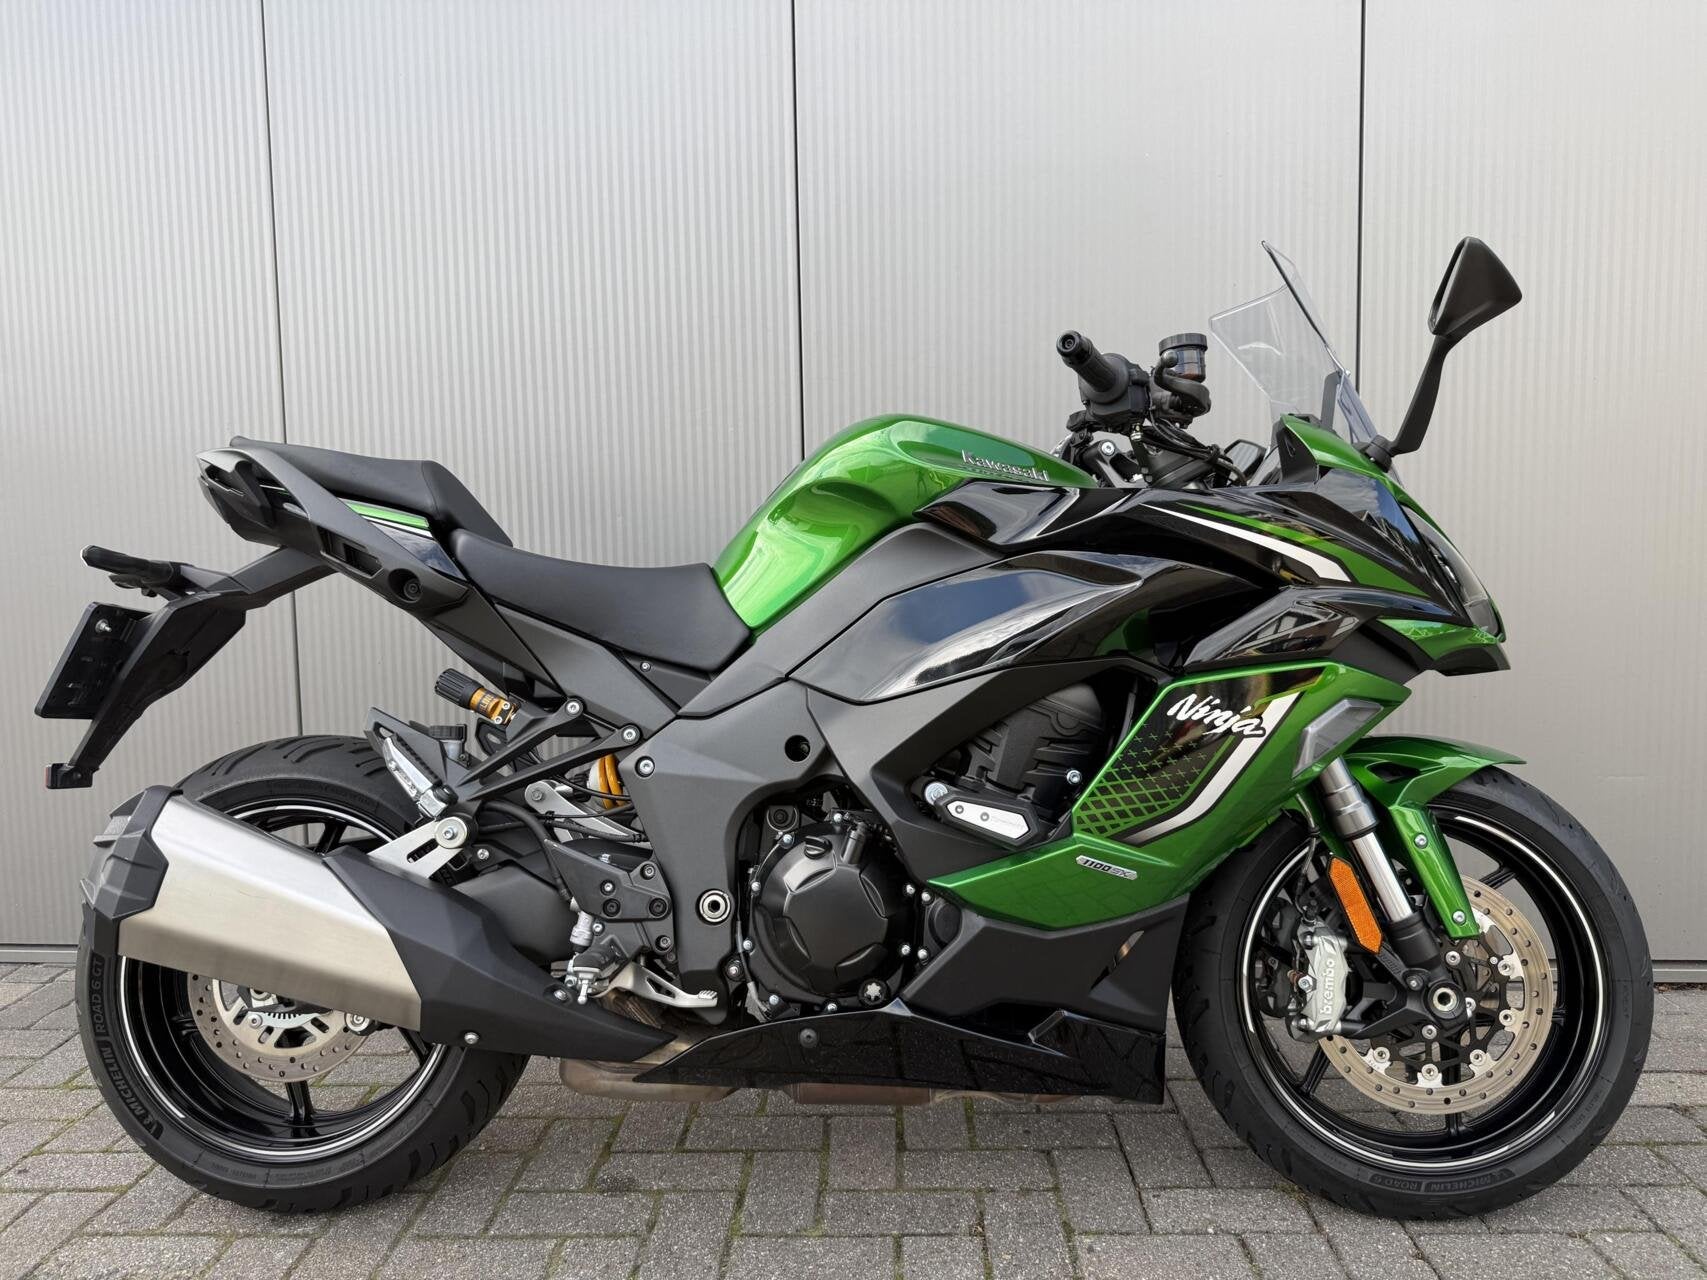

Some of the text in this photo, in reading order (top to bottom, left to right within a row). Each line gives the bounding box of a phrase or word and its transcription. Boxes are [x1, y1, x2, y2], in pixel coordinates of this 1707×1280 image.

[961, 449, 1049, 481] Kawasaki
[1167, 693, 1264, 735] Ninja
[1320, 957, 1336, 1015] brembo
[91, 957, 146, 1117] MICHELIN ROAD 6 GT
[1384, 1178, 1418, 1191] ROAD
[1431, 1176, 1492, 1192] MICHELIN
